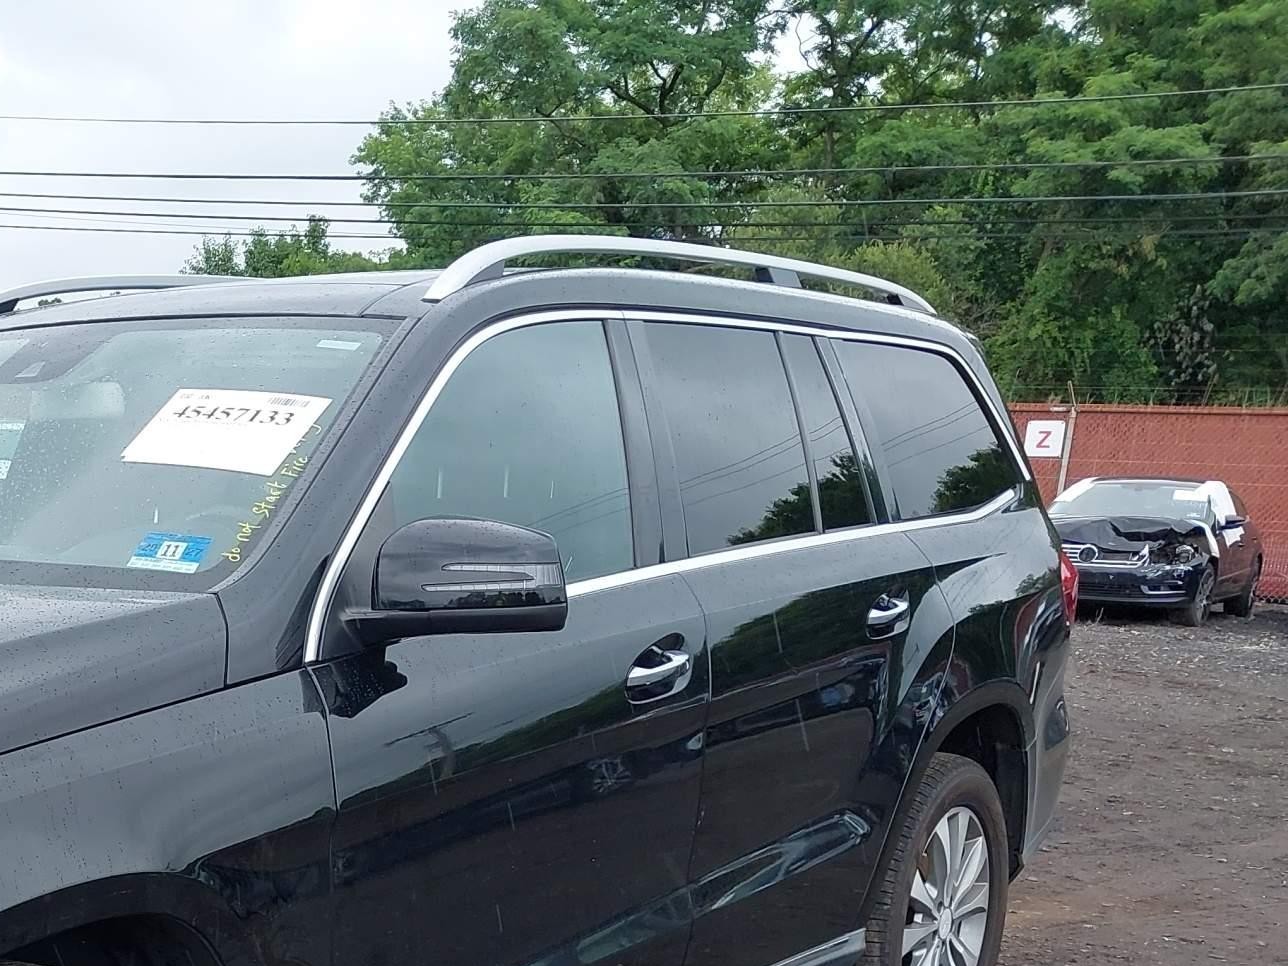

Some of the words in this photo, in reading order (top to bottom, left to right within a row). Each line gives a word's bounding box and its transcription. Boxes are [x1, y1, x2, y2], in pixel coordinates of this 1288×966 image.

[173, 405, 295, 426] 45457133
[1036, 430, 1053, 449] Z
[160, 543, 180, 558] 11
[221, 545, 241, 562] do
[236, 522, 262, 542] not
